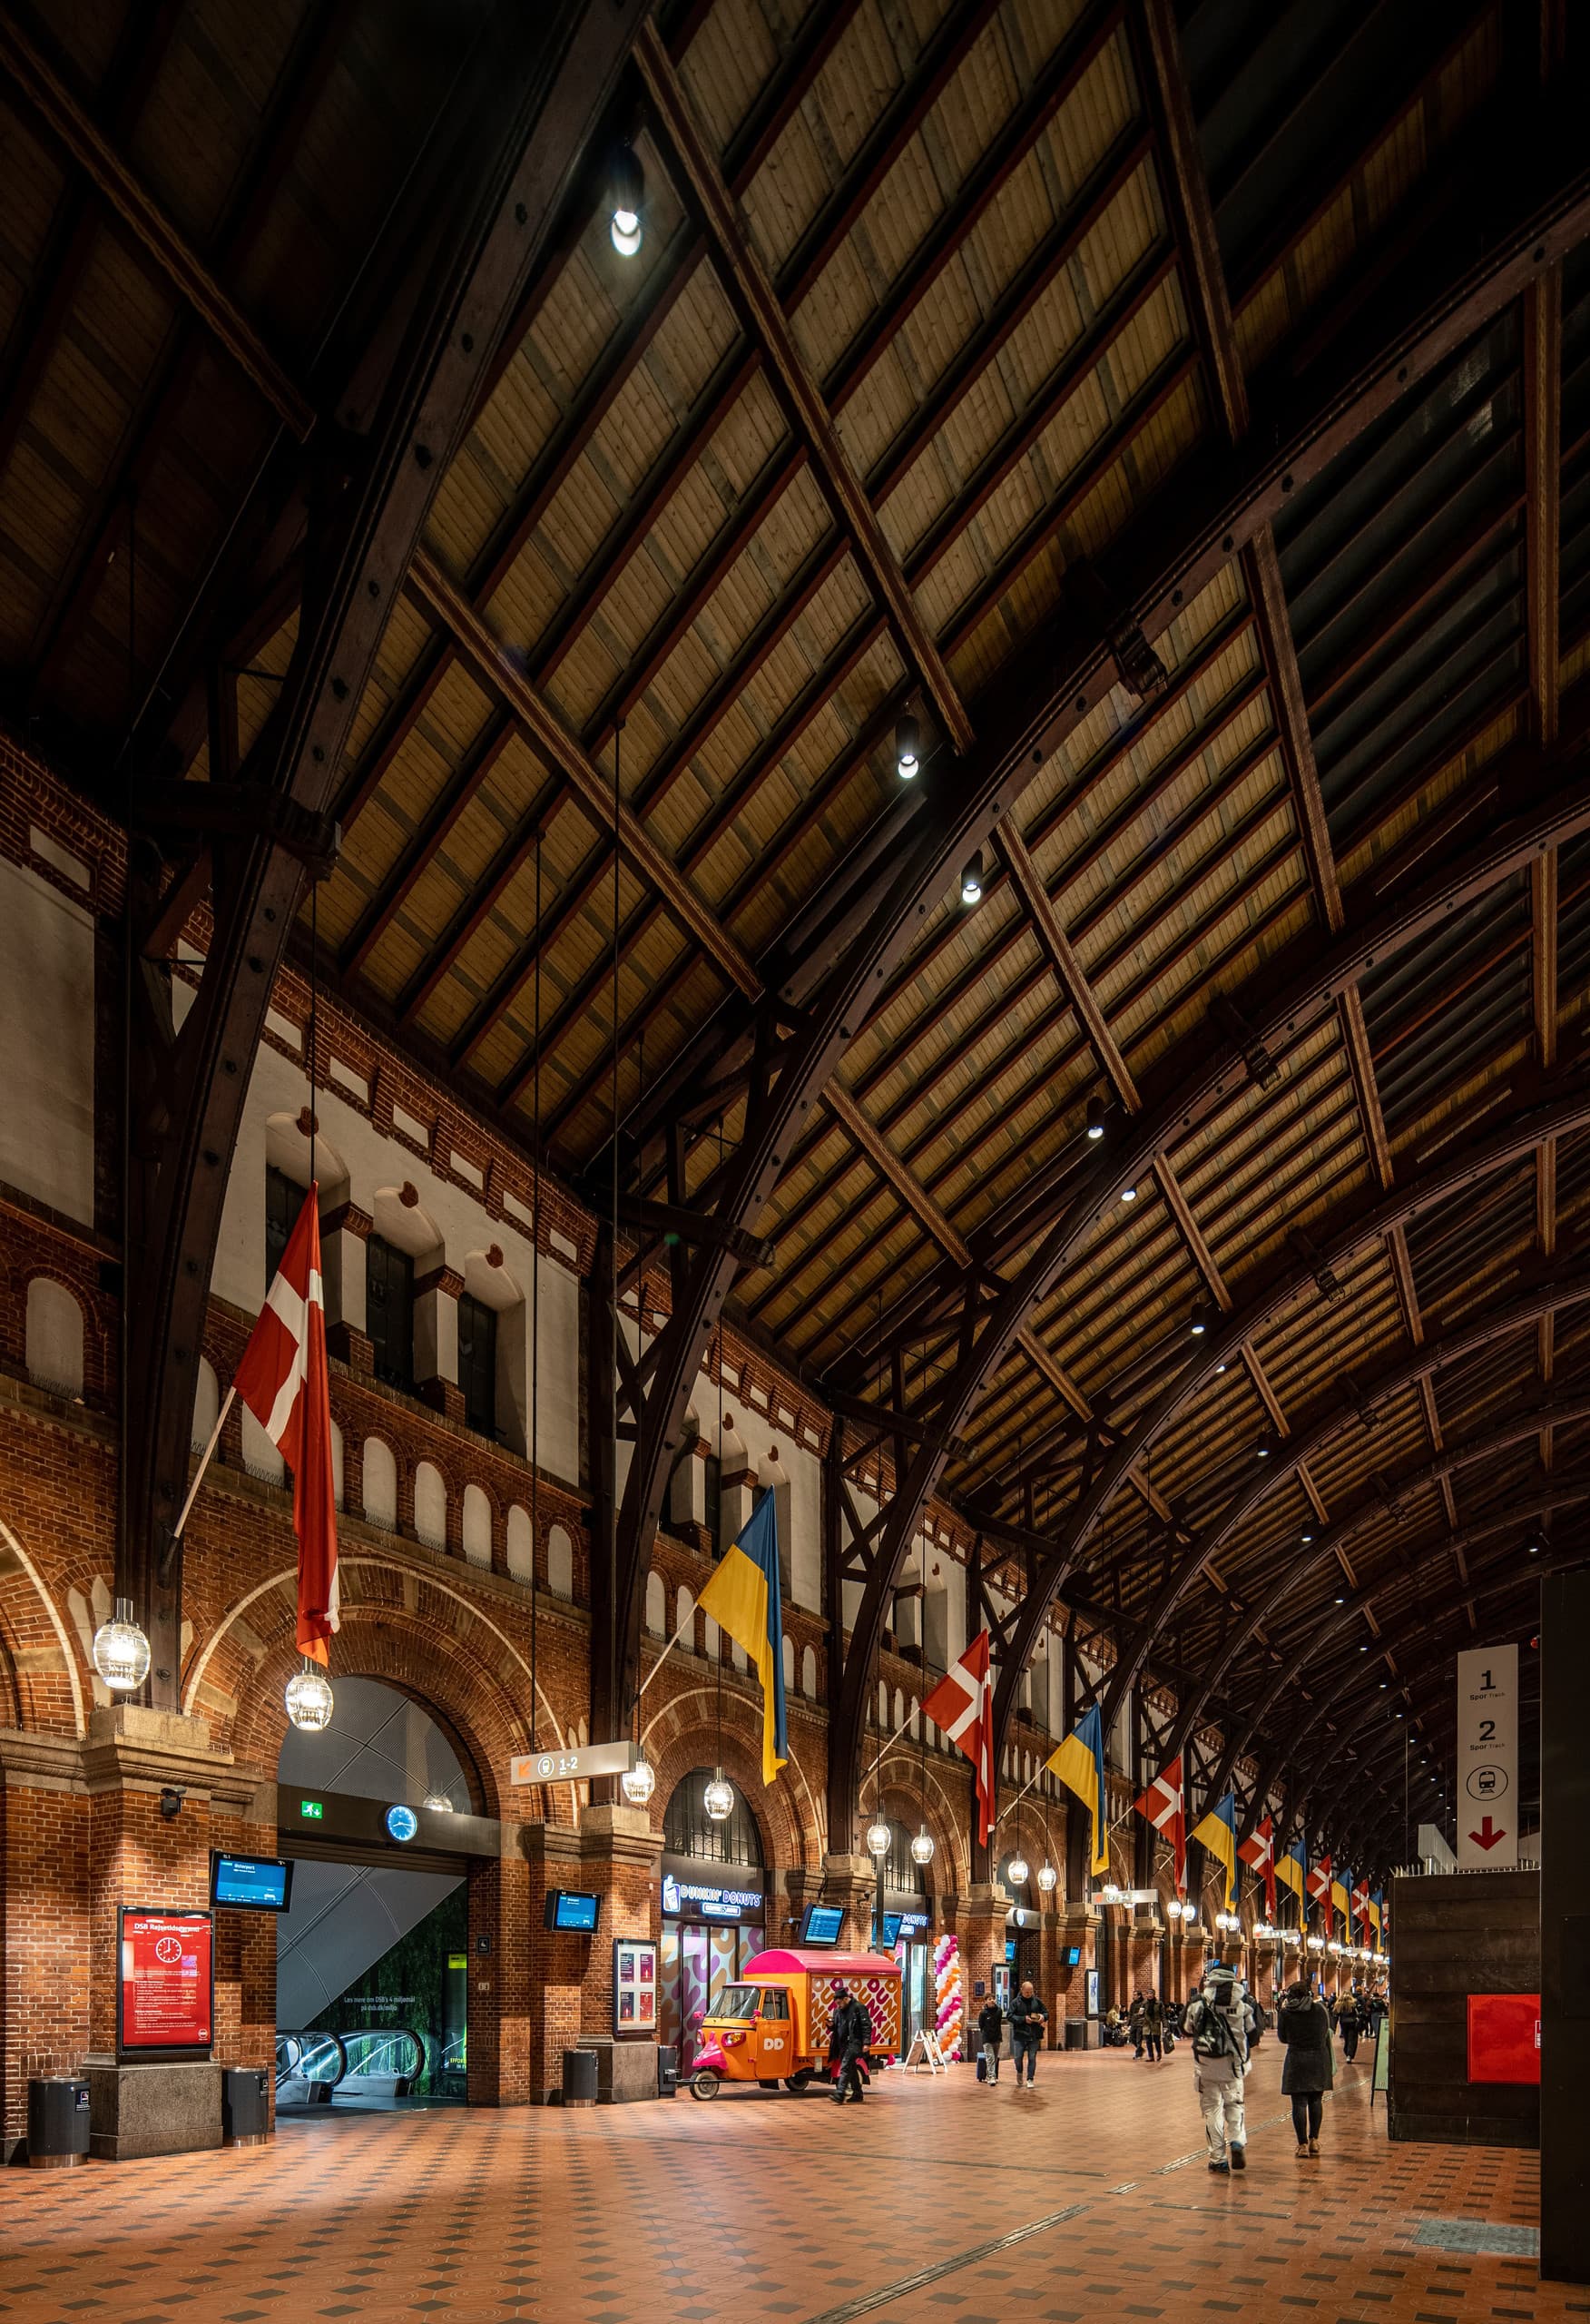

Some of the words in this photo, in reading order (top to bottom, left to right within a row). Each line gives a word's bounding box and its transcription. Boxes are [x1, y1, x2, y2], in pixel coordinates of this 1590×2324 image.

[1480, 1669, 1496, 1690] 1
[1469, 1693, 1487, 1701] Spor
[1479, 1720, 1496, 1741] 2
[559, 1757, 578, 1771] 1-2
[680, 1885, 722, 1902] DUNKIN'
[722, 1890, 761, 1907] DONUTS
[763, 2037, 785, 2051] DD
